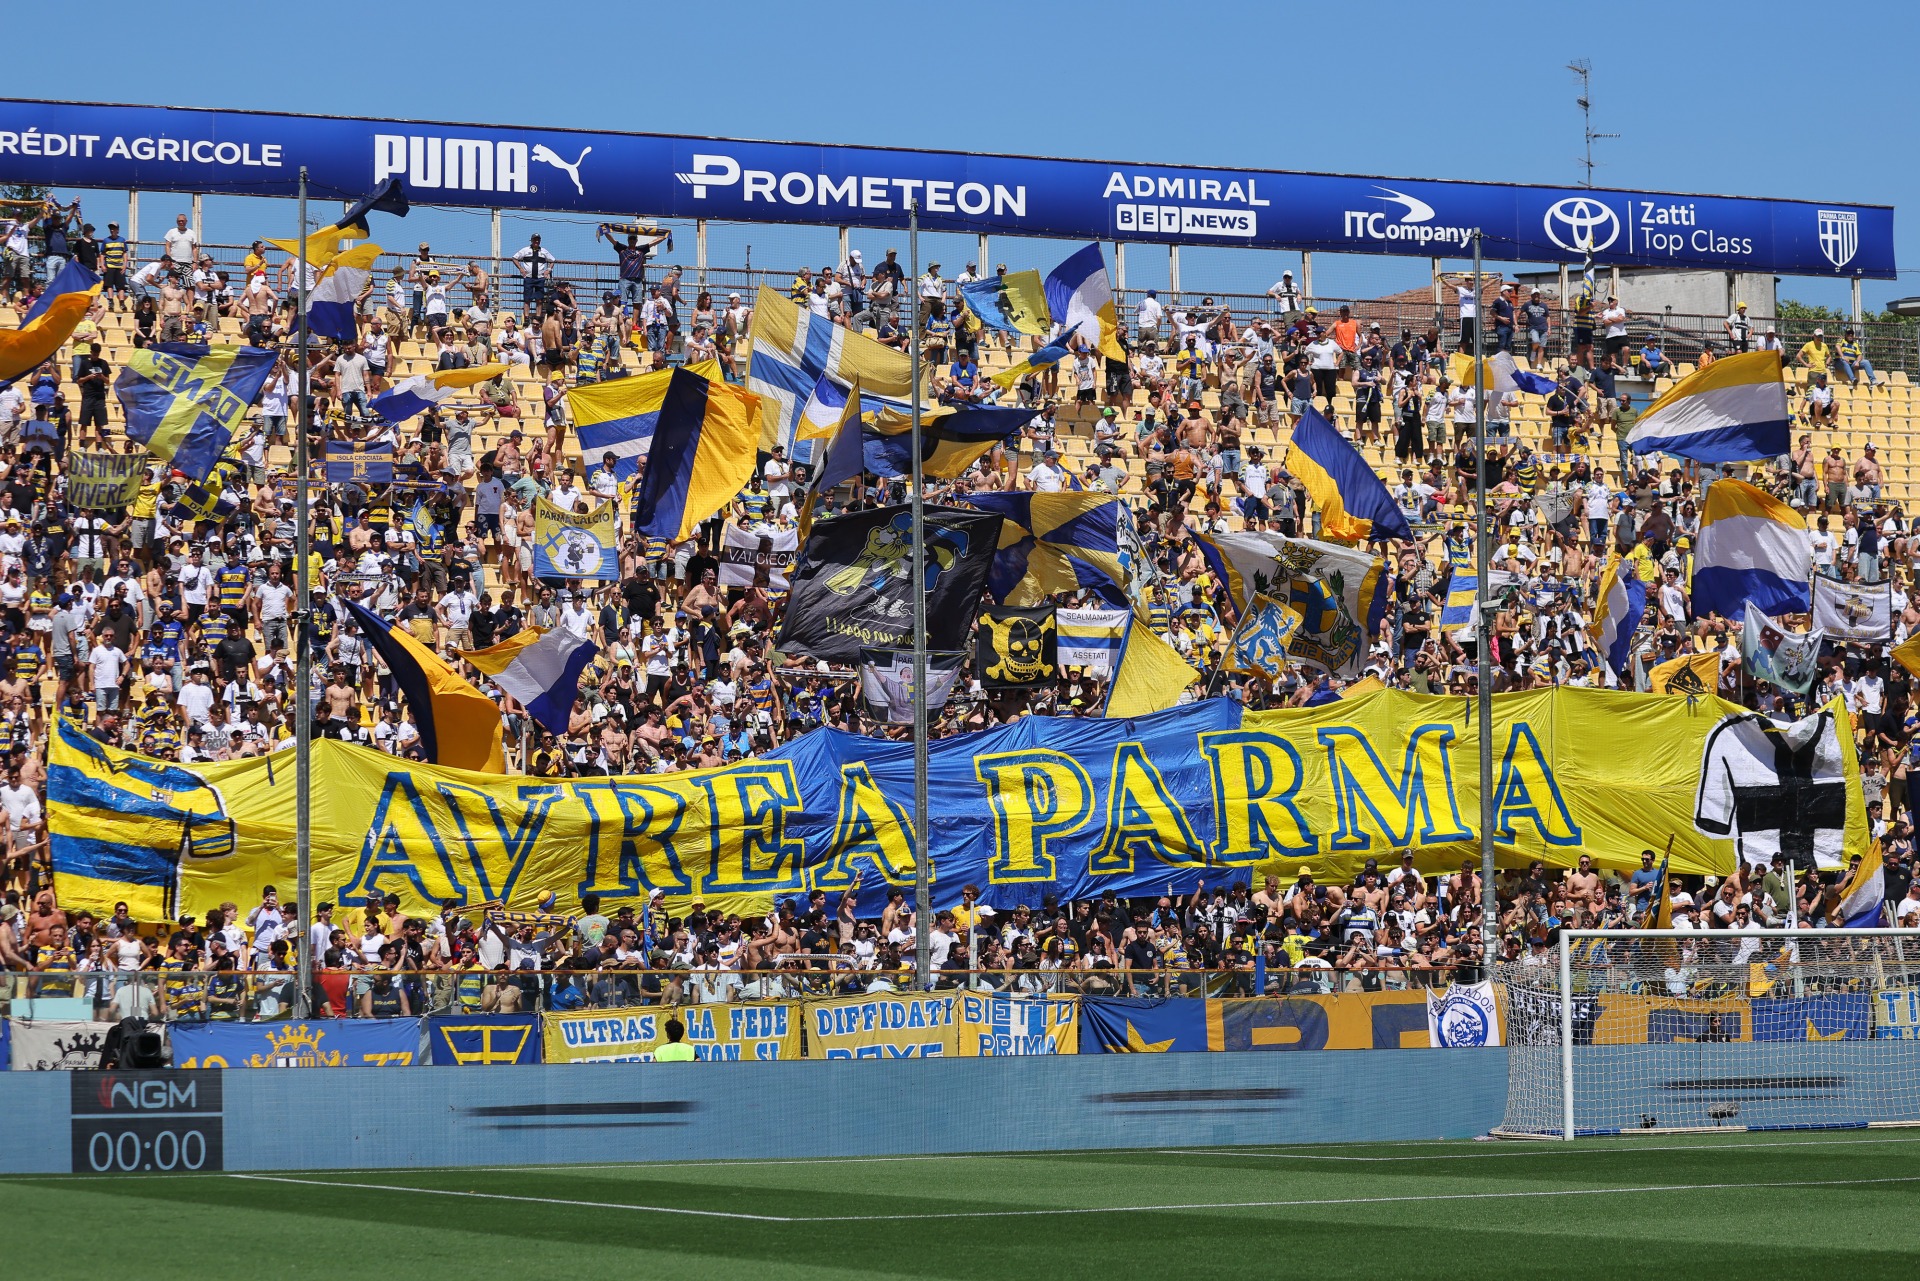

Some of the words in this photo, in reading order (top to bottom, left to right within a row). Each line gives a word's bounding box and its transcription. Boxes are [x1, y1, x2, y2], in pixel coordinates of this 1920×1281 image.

[105, 134, 282, 167] AGRICOLE
[374, 134, 528, 193] PUMA
[1103, 172, 1270, 206] ADMIRAL
[1344, 210, 1473, 249] ITCompany
[1640, 201, 1696, 228] Zatti
[1820, 212, 1838, 220] PARMA
[1838, 213, 1856, 221] CALCIO
[1640, 227, 1684, 256] Top
[1691, 230, 1752, 255] Class
[539, 509, 572, 525] PARMA
[573, 511, 610, 526] CALCIO
[1066, 612, 1114, 621] SCALMANATI
[1072, 652, 1107, 660] ASSETATI
[337, 759, 937, 907] AVREA
[973, 720, 1584, 885] PARMA
[560, 1015, 658, 1048] ULTRAS
[686, 1008, 717, 1041] LA
[729, 1004, 788, 1040] FEDE
[815, 997, 954, 1036] DIFFIDATI
[978, 1032, 1058, 1057] PRIMA
[110, 1078, 197, 1109] NGM
[88, 1129, 207, 1172] 00:00
